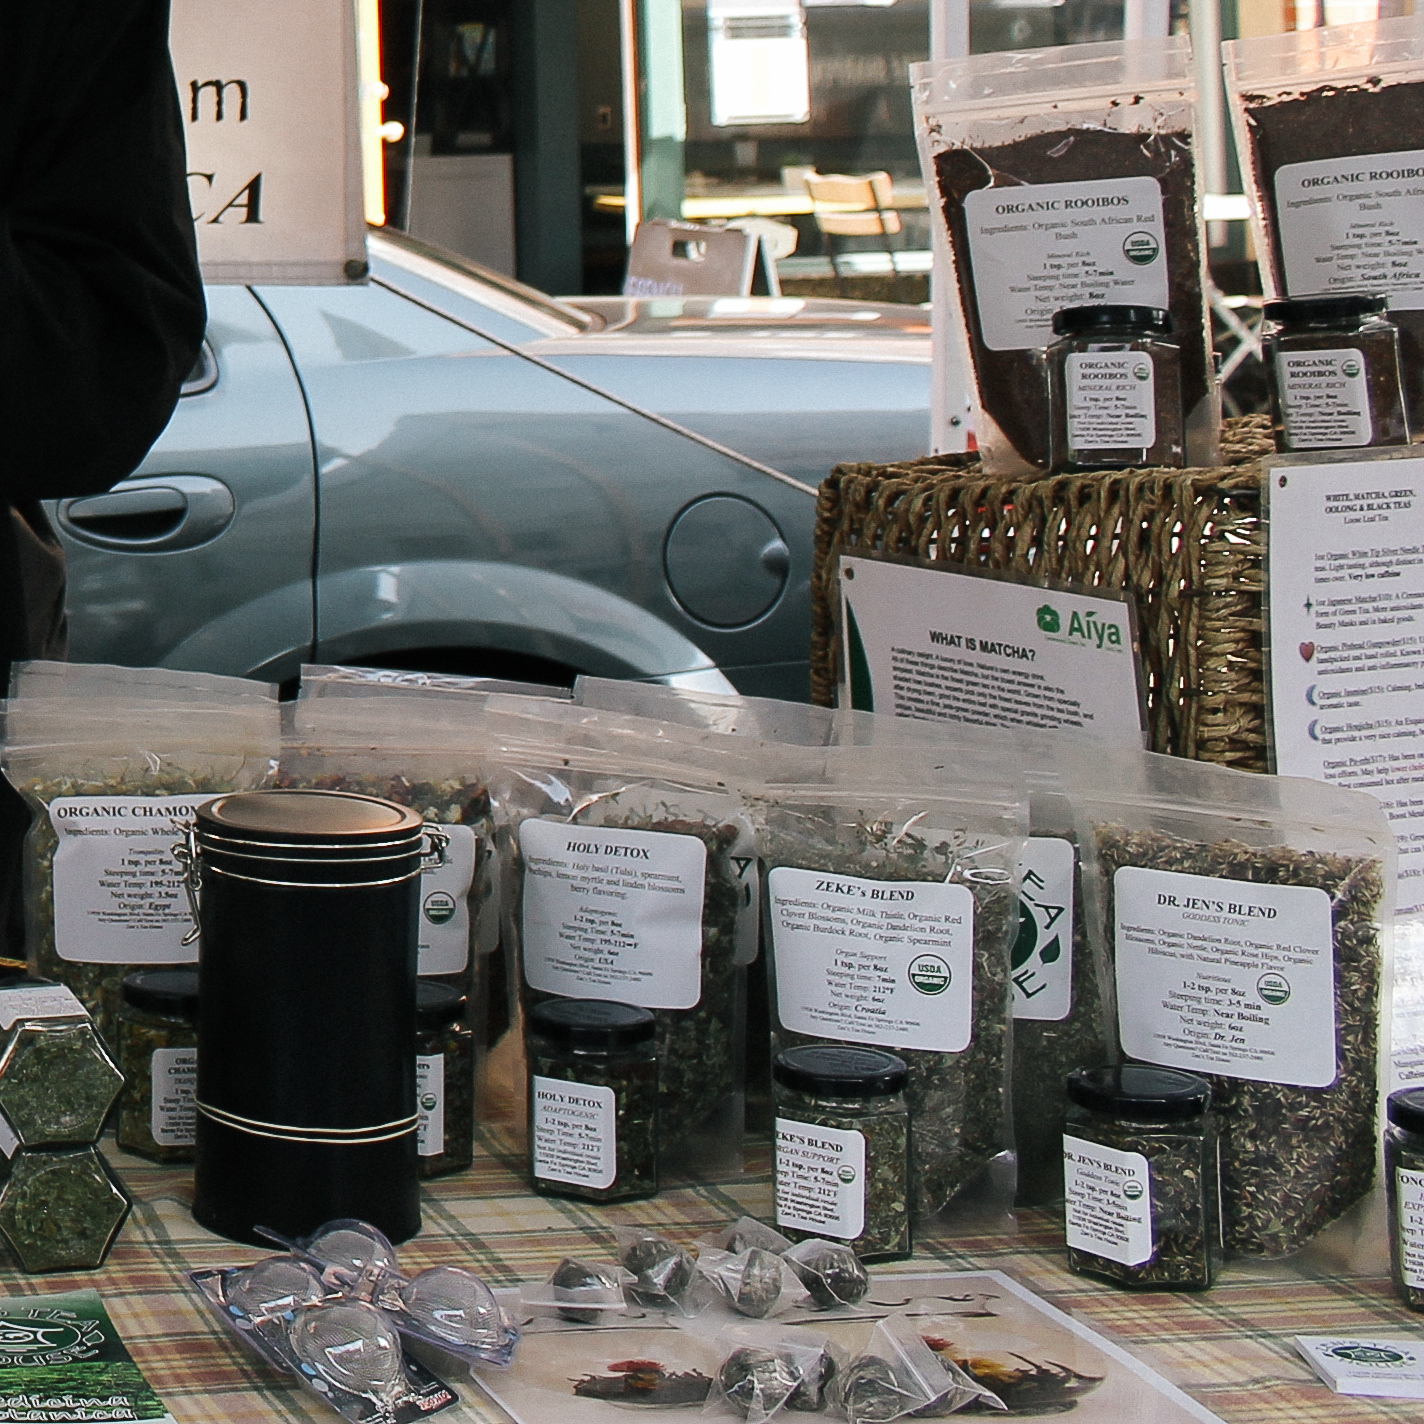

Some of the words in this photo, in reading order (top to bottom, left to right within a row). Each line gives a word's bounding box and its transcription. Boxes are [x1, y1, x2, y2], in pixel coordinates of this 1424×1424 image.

[1300, 172, 1364, 188] ORGANIC
[1369, 167, 1424, 180] ROOIBO
[995, 200, 1060, 214] ORGANIC
[1064, 195, 1129, 209] ROOIBOS
[1068, 610, 1122, 650] Aiya
[928, 630, 963, 647] WHAT
[964, 637, 976, 651] IS
[979, 639, 1035, 661] MATCHA?
[56, 805, 127, 818] ORGANIC
[131, 805, 200, 819] CHAMO
[566, 841, 601, 854] HOLY
[604, 844, 649, 859] DETOX
[815, 879, 866, 897] ZEKE's
[870, 888, 914, 900] BLEND
[1020, 869, 1065, 929] EA
[1157, 893, 1180, 907] DR.
[1182, 897, 1223, 912] JEN'S
[1227, 902, 1276, 918] BLEND
[1182, 980, 1195, 990] 1-2
[1197, 983, 1212, 993] tsp.
[1215, 987, 1228, 995] per
[1230, 987, 1245, 997] 8oz
[537, 1088, 565, 1103] HOLY
[567, 1095, 602, 1109] DETOX
[776, 1131, 805, 1144] EKE'S
[807, 1137, 843, 1152] BLEND
[21, 1307, 100, 1332] TEA
